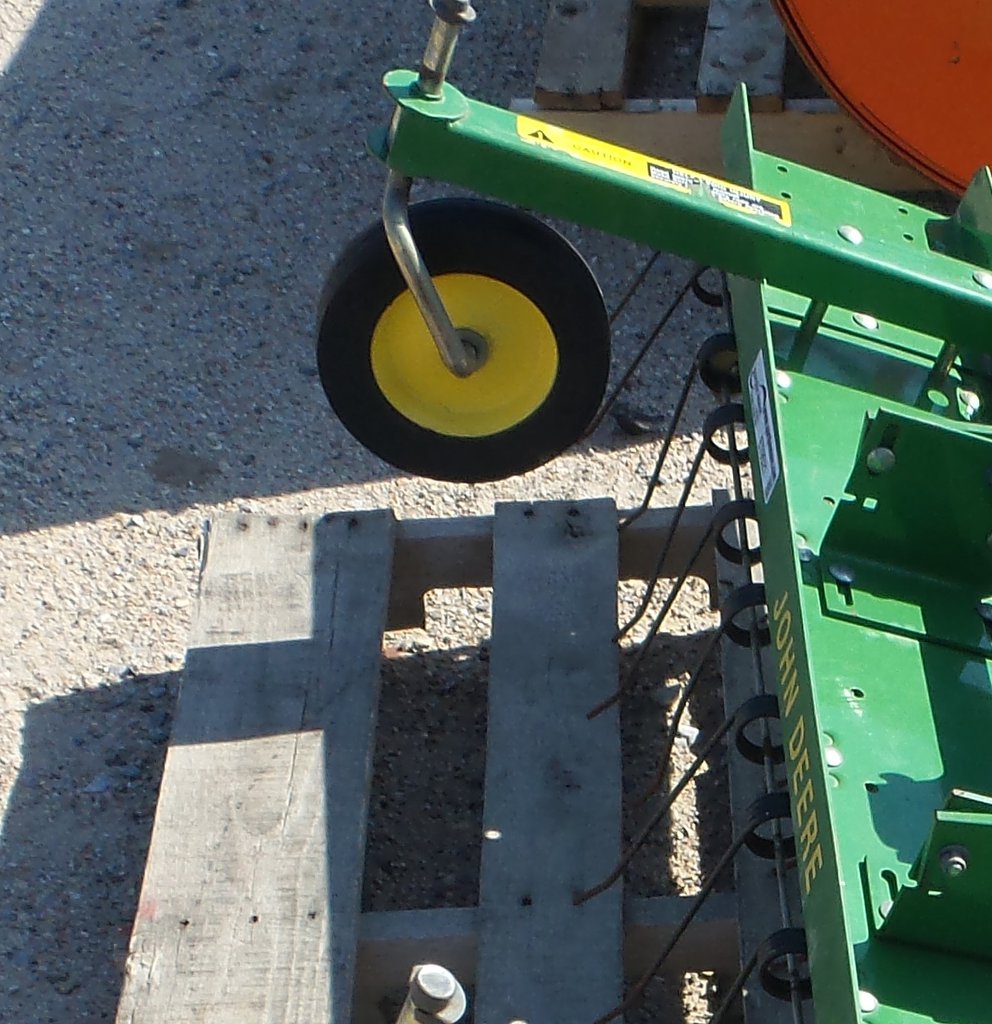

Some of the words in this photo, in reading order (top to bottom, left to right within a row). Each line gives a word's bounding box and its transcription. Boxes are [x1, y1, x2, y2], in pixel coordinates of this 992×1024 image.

[573, 144, 632, 166] CAUTION
[774, 591, 800, 718] JOHN
[789, 715, 825, 896] DEERE
